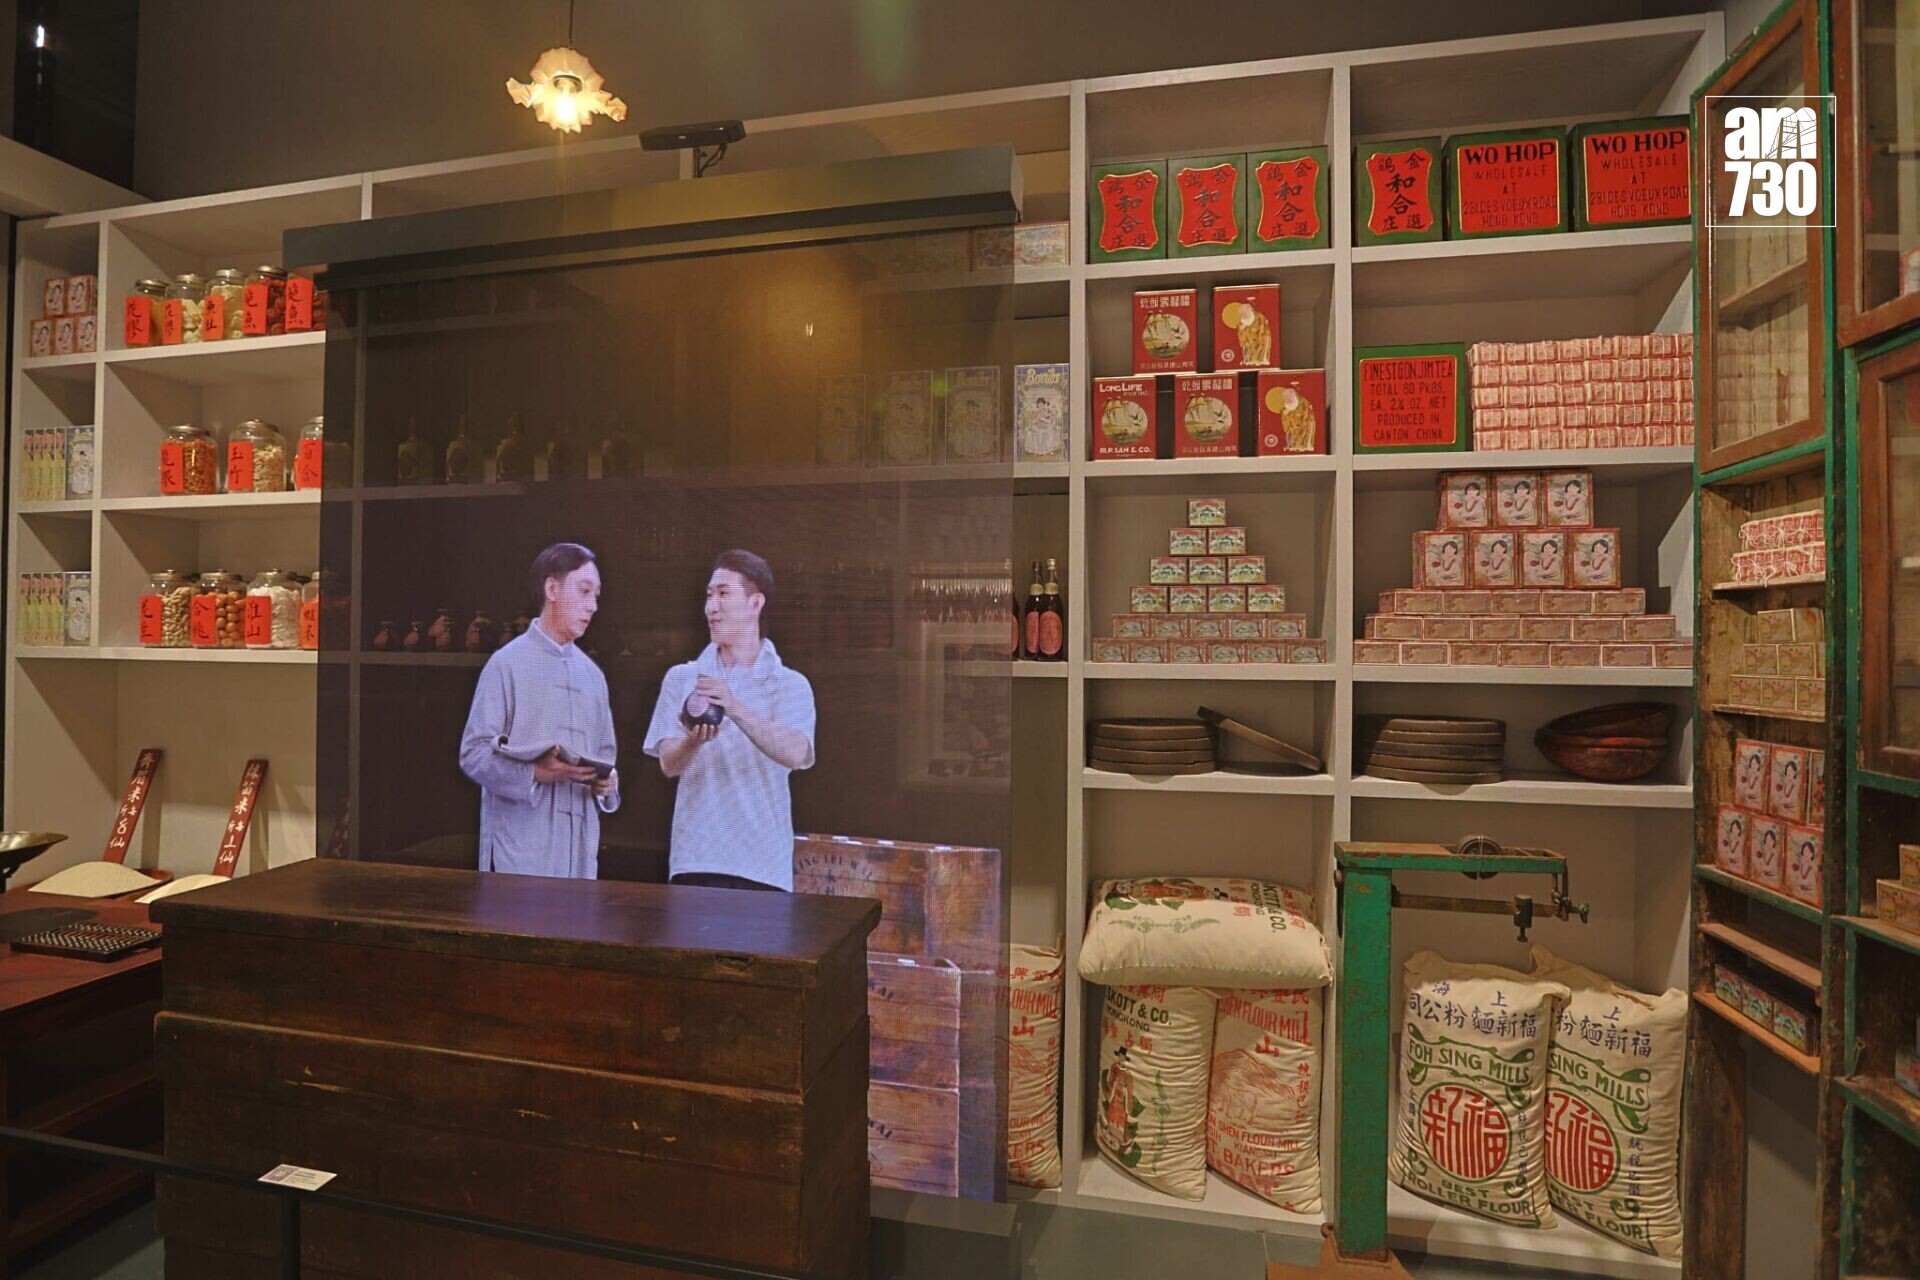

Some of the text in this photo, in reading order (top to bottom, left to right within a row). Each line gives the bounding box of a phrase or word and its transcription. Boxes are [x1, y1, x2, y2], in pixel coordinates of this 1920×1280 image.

[1592, 131, 1686, 154] WO HOP
[1465, 142, 1555, 165] WO HOP
[1601, 154, 1676, 171] WHOLESALE
[1473, 165, 1547, 180] WHOLESALE
[1631, 172, 1646, 185] AT
[1385, 173, 1417, 214] 和合
[1502, 182, 1517, 195] AT
[1607, 190, 1626, 203] DES
[1628, 188, 1661, 202] VOEUX
[1662, 186, 1688, 199] ROAD
[1193, 189, 1222, 226] 和合
[1275, 181, 1304, 222] 和合
[1480, 199, 1497, 213] DES
[1501, 197, 1532, 212] VOEUX
[1533, 194, 1557, 209] ROAD
[1611, 203, 1669, 218] HONG KONG
[1114, 195, 1143, 234] 和合
[1482, 212, 1538, 227] HONG KONG
[1363, 361, 1397, 381] FINEST
[1435, 360, 1452, 378] TEA
[1370, 383, 1398, 395] TOTAL
[1429, 396, 1448, 409] NET
[1377, 411, 1440, 426] PRODUCED IN
[1374, 427, 1442, 441] CANTON CHINA
[302, 442, 320, 483] 百合
[1269, 916, 1288, 933] CO.
[1106, 986, 1137, 1014] SKOTT
[1138, 1003, 1147, 1020] &
[1150, 1006, 1172, 1026] CO.
[1602, 1006, 1622, 1021] 上
[1012, 1015, 1035, 1036] 山
[1242, 1000, 1277, 1034] FLOUR
[1255, 1035, 1280, 1057] 山
[1409, 1039, 1530, 1085] FOH SING MILLS
[1549, 1052, 1646, 1107] SING MILLS
[1241, 1130, 1276, 1147] FLOUR
[1223, 1147, 1296, 1177] BAKERS
[1408, 1171, 1530, 1215] ROLLER FLOUR
[1441, 1179, 1490, 1199] BEST
[1584, 1211, 1643, 1239] FLOUR
